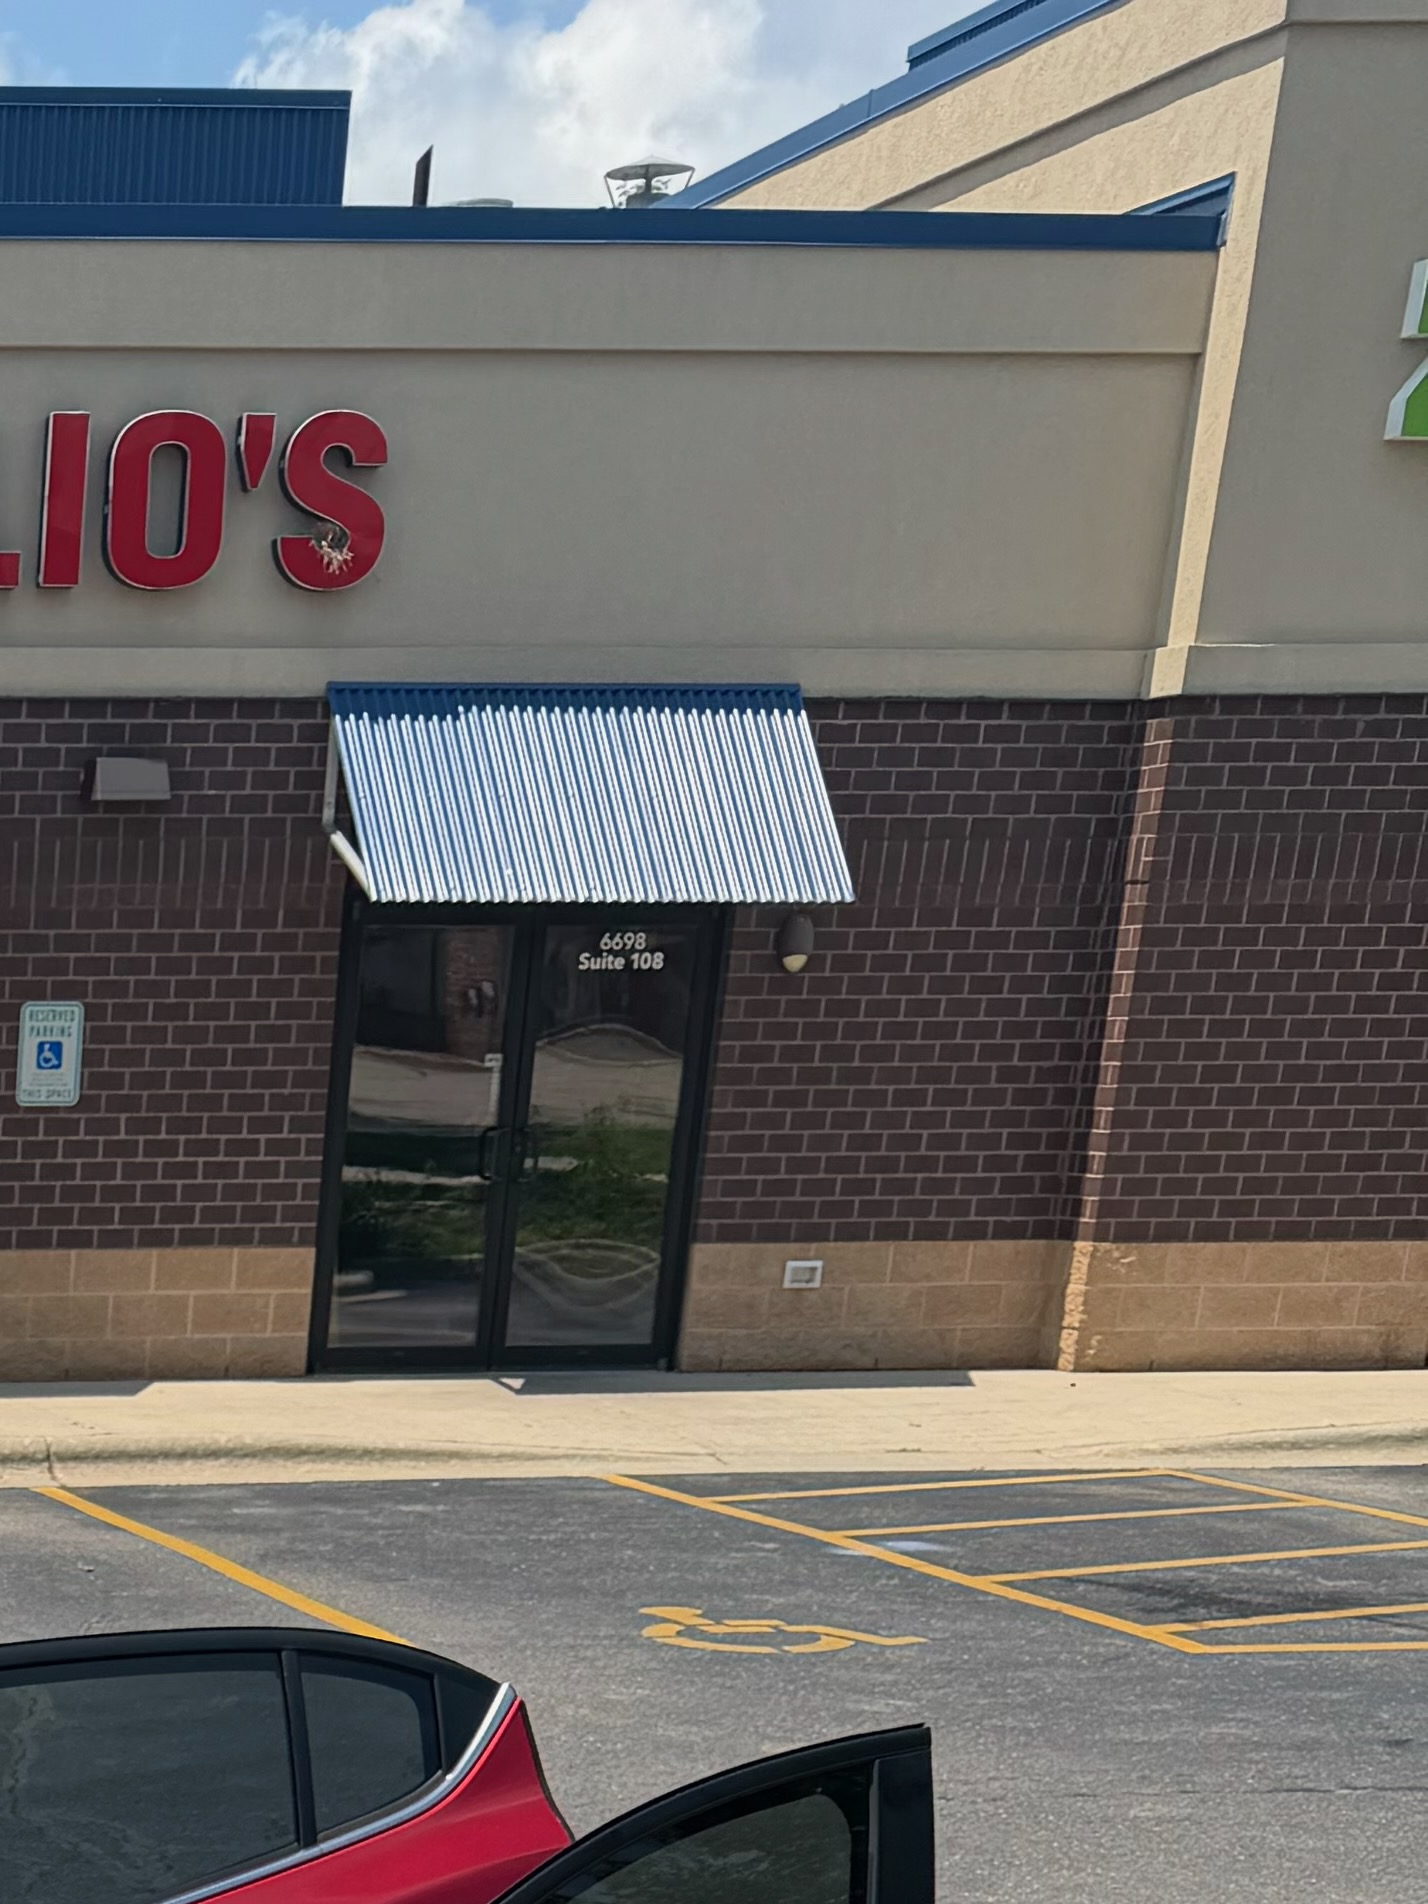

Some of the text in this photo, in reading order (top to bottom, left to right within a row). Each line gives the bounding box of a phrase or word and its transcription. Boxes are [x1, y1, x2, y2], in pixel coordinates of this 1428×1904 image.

[600, 931, 647, 950] 6698
[578, 951, 665, 970] Suite 108
[28, 1008, 76, 1022] RESERVED
